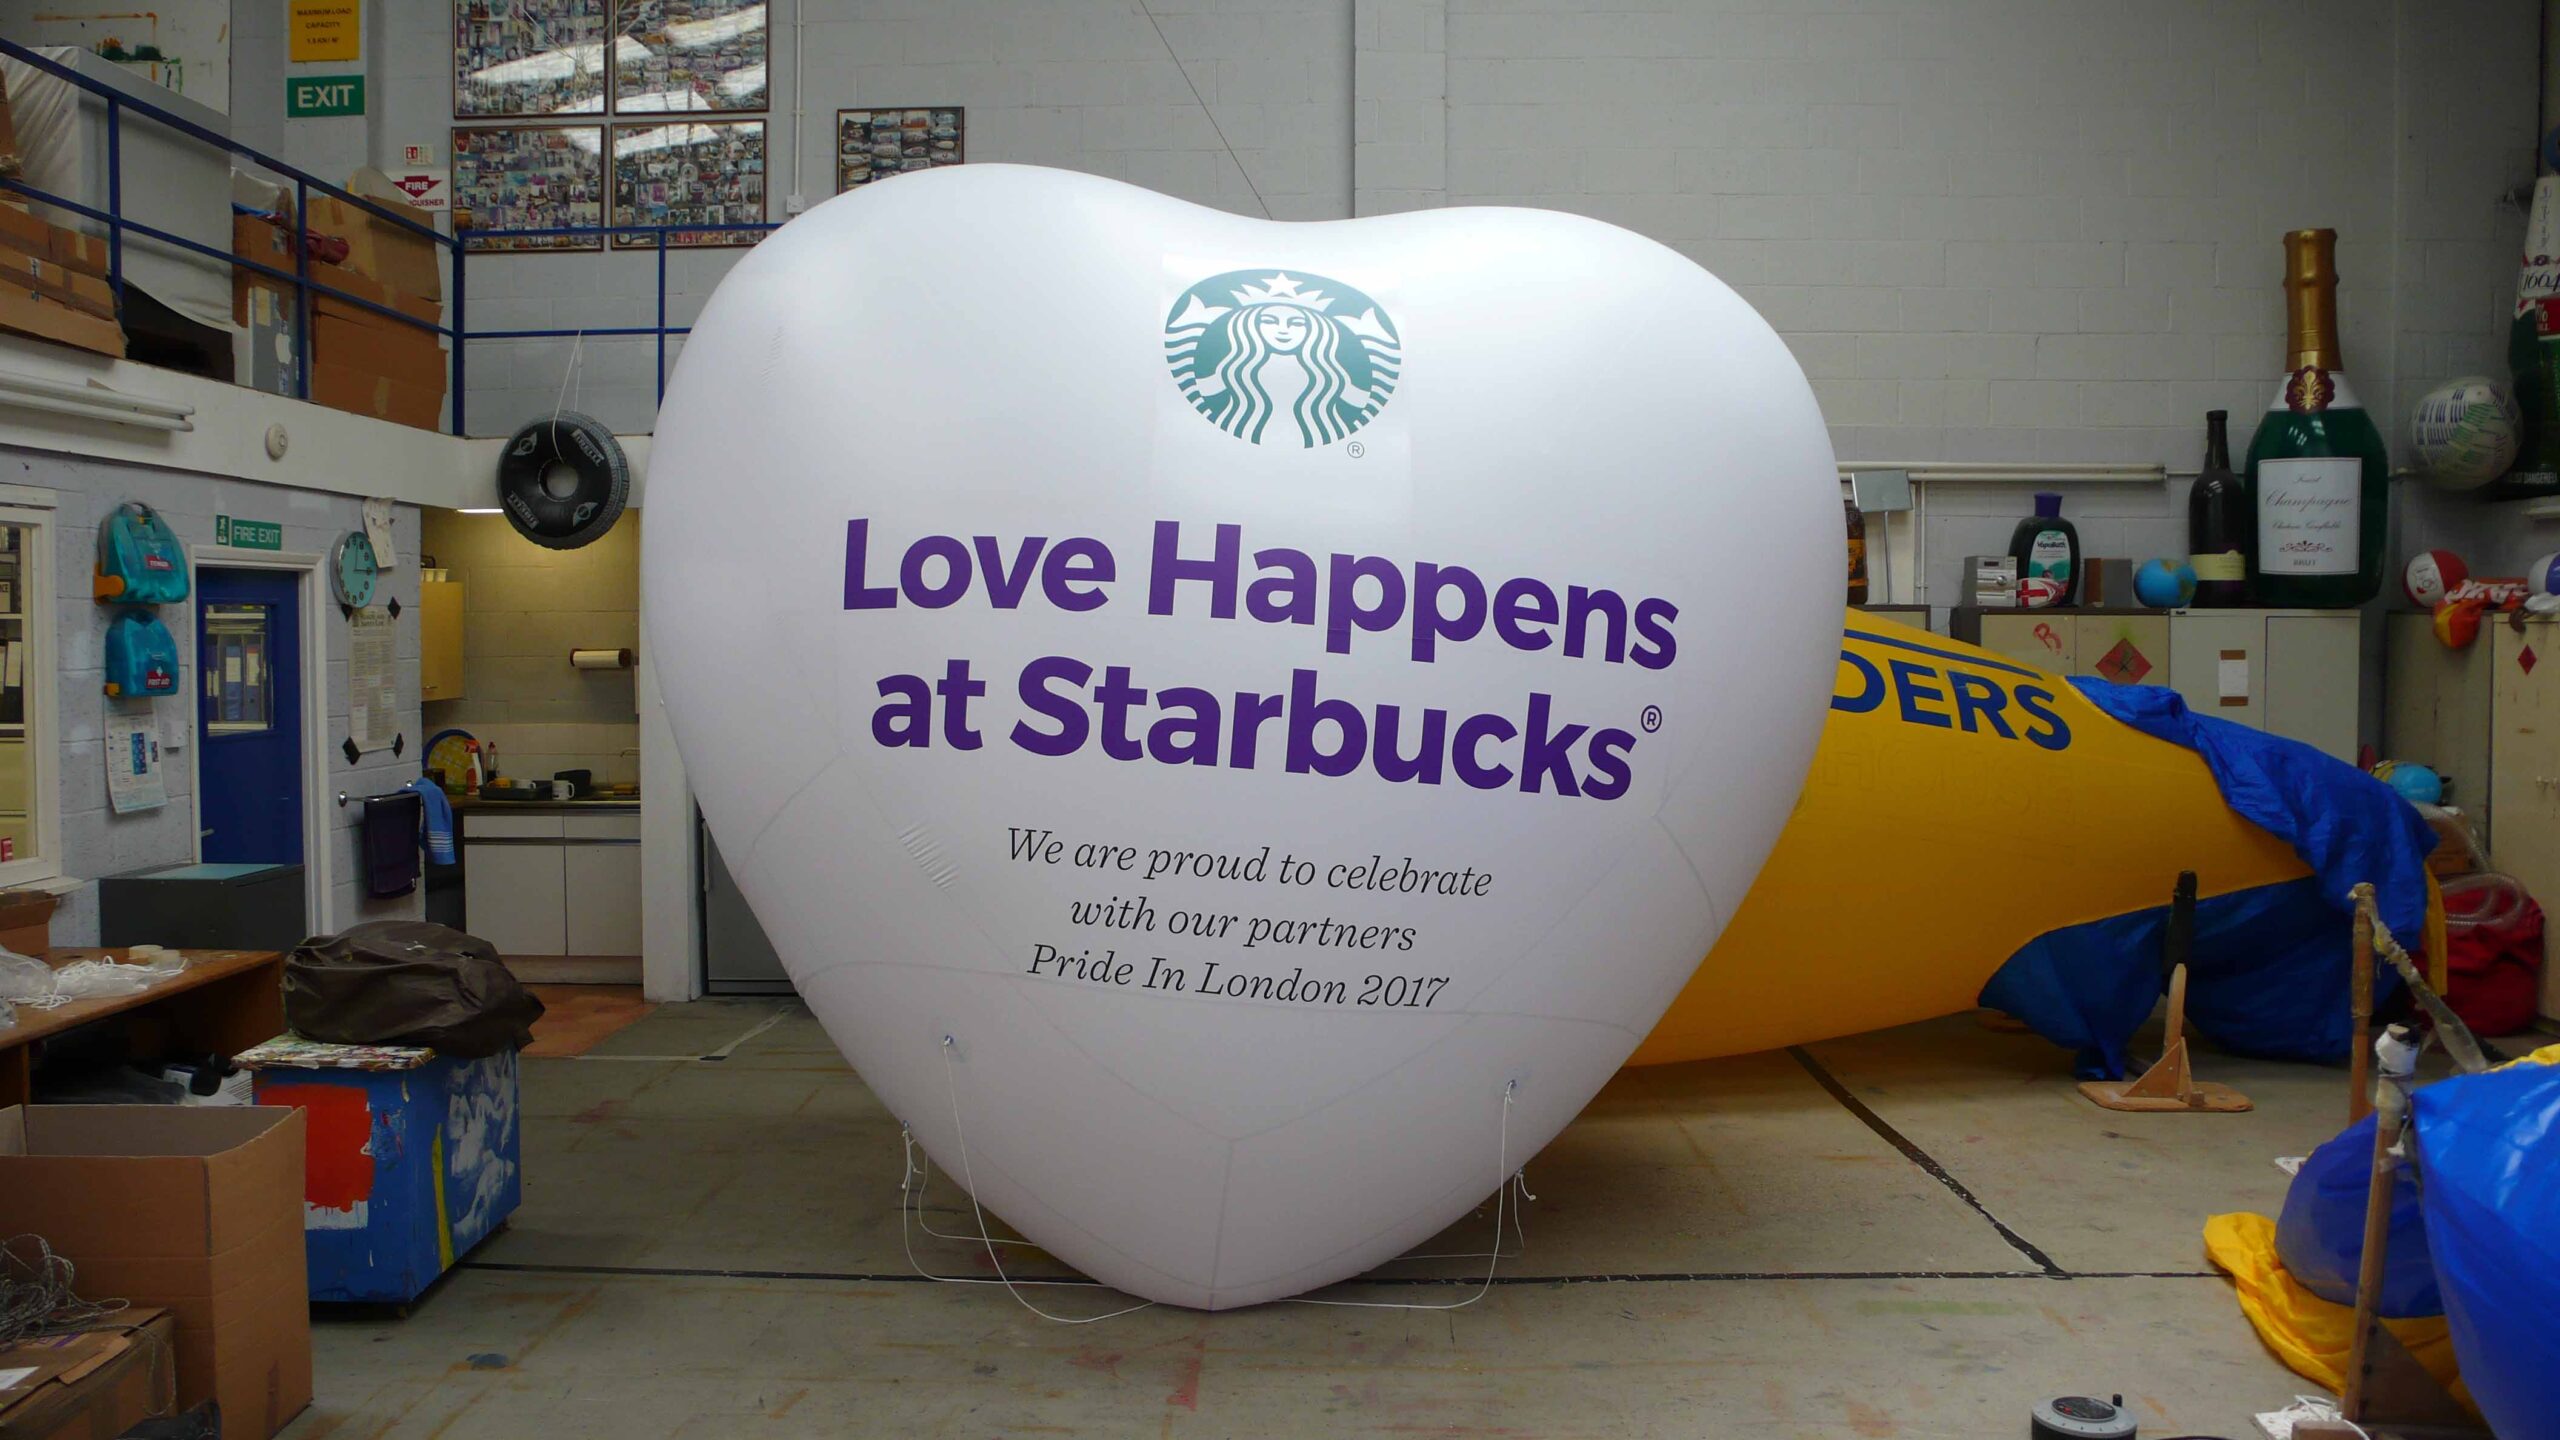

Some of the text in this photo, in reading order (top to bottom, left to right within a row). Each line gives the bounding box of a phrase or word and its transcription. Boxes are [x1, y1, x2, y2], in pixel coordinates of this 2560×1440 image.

[305, 21, 341, 29] CAPACITY
[297, 84, 356, 109] EXIT
[405, 181, 428, 191] FIRE
[2265, 488, 2353, 513] Champagne
[233, 525, 281, 545] FIRE EXIT
[2293, 559, 2316, 567] BRUT
[844, 518, 1680, 671] Love Happens
[872, 659, 987, 752] at
[1008, 826, 1494, 897] We are proud to celebrate
[1070, 895, 1418, 952] with our partners
[1025, 943, 1451, 1010] Pride In London 2017
